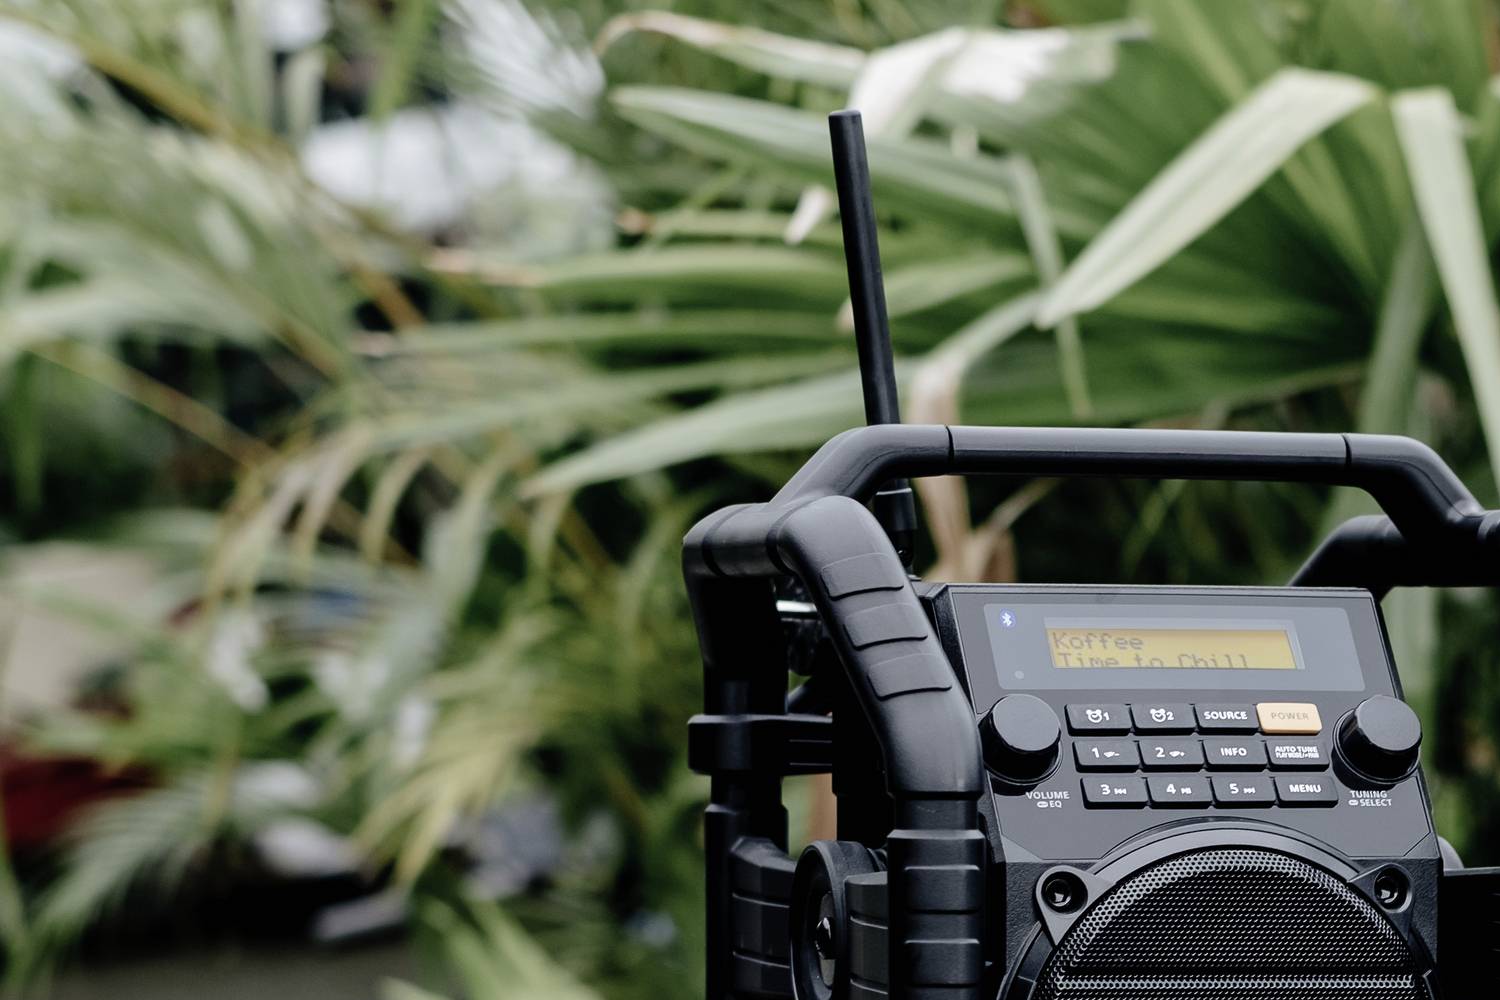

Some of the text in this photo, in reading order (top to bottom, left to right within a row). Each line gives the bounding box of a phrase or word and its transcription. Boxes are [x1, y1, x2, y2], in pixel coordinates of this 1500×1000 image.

[1052, 631, 1144, 650] Koffee
[1057, 652, 1120, 668] Time
[1177, 653, 1250, 669] Chill
[1103, 712, 1110, 721] 1
[1166, 712, 1175, 721] 2
[1203, 711, 1248, 720] SOURCE
[1271, 712, 1309, 720] POWER
[1091, 748, 1100, 758] 1
[1155, 747, 1165, 758] 2
[1220, 747, 1248, 757] INFO
[1274, 745, 1318, 753] AUTO TUNE
[1100, 784, 1111, 795] 3
[1166, 784, 1176, 794] 4
[1229, 783, 1239, 794] 5
[1289, 784, 1322, 793] MENU
[1025, 791, 1070, 800] VOLUME
[1350, 790, 1388, 799] TUNING
[1049, 800, 1063, 808] EQ
[1360, 799, 1392, 807] SELECT
